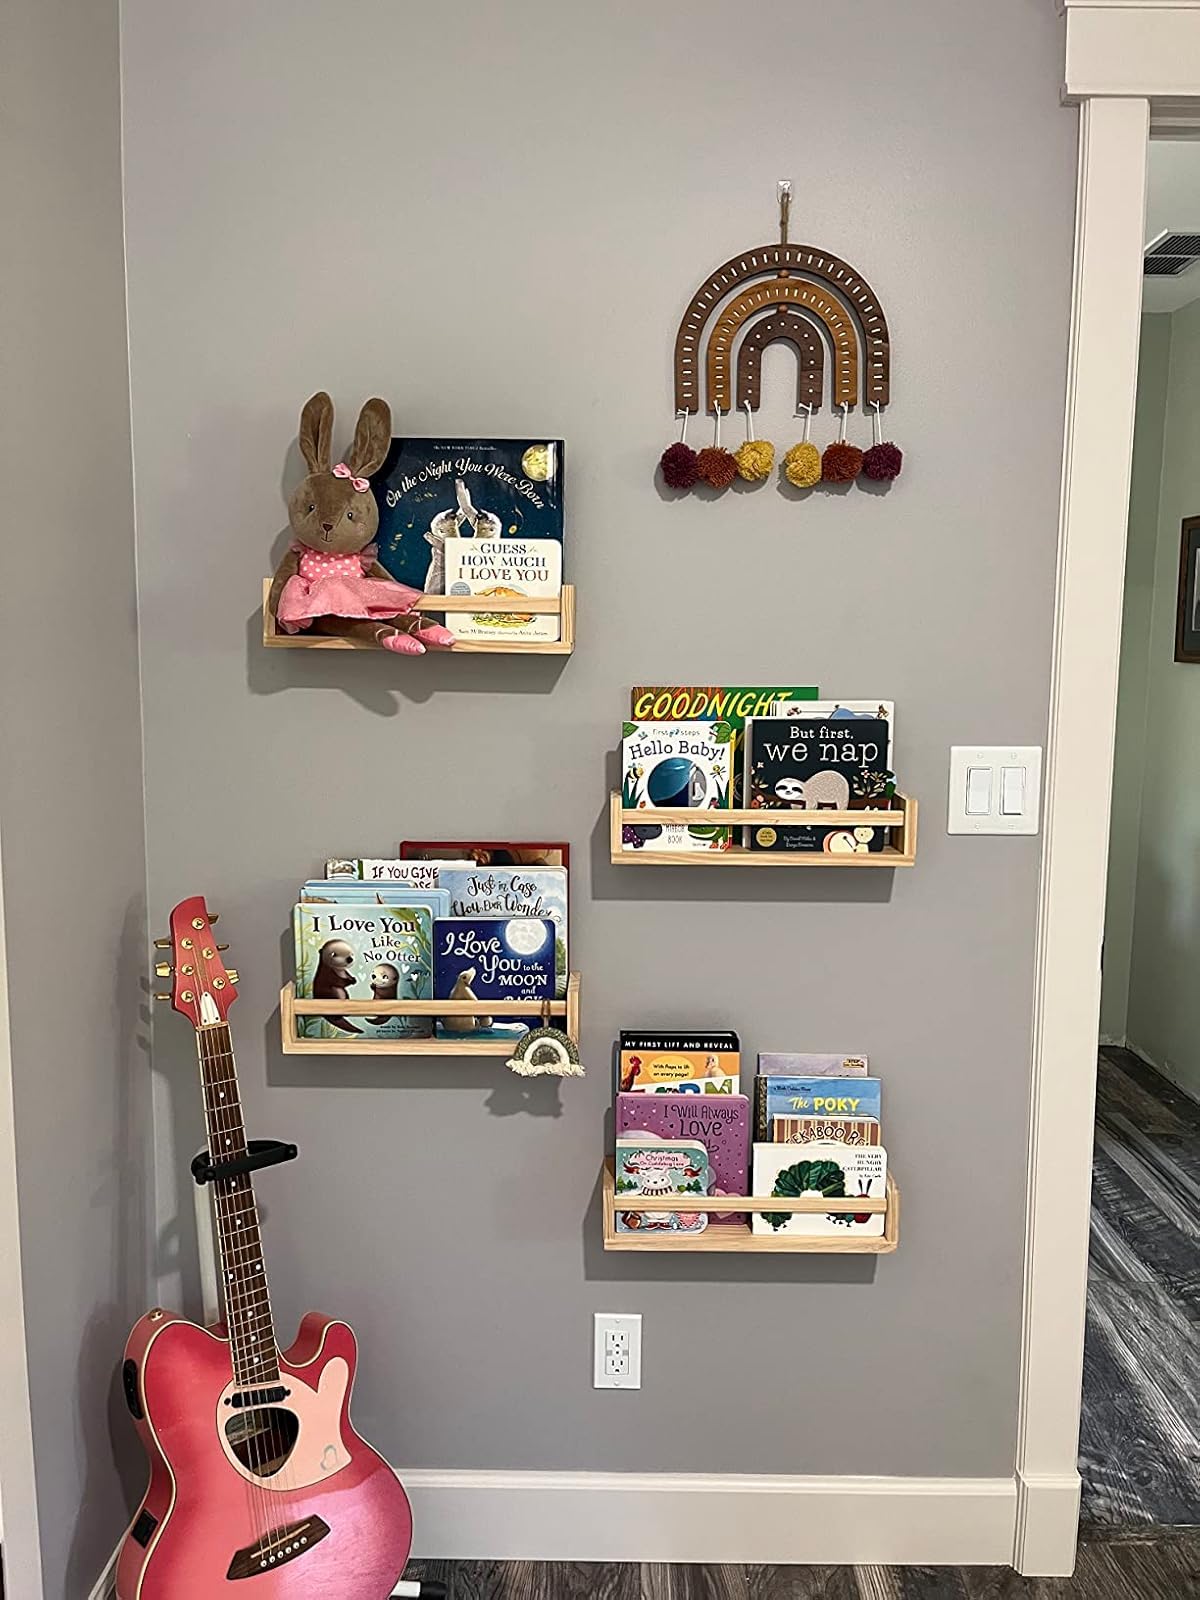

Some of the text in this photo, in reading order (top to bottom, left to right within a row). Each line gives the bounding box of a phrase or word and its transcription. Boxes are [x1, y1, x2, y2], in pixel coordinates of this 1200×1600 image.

[386, 457, 545, 510] On the Night You Were Born
[480, 543, 527, 554] GUESS
[461, 555, 546, 568] HOW MUCH
[458, 568, 550, 582] I LOVE YOU
[790, 726, 816, 739] But
[629, 740, 725, 761] Hello Baby!
[763, 742, 879, 768] we nap
[372, 866, 439, 879] IF YOU GIVE
[467, 874, 538, 898] Just in Case
[452, 899, 481, 916] You
[497, 893, 553, 917] Wonder
[312, 915, 416, 934] I Love You
[371, 936, 401, 949] Like
[457, 931, 503, 957] Love
[364, 950, 421, 964] No Otter
[531, 962, 544, 971] the
[498, 974, 548, 986] MOON
[521, 985, 537, 994] and
[789, 1096, 860, 1112] The POKY
[664, 1104, 740, 1124] I Will Always
[645, 1154, 679, 1162] Christmas
